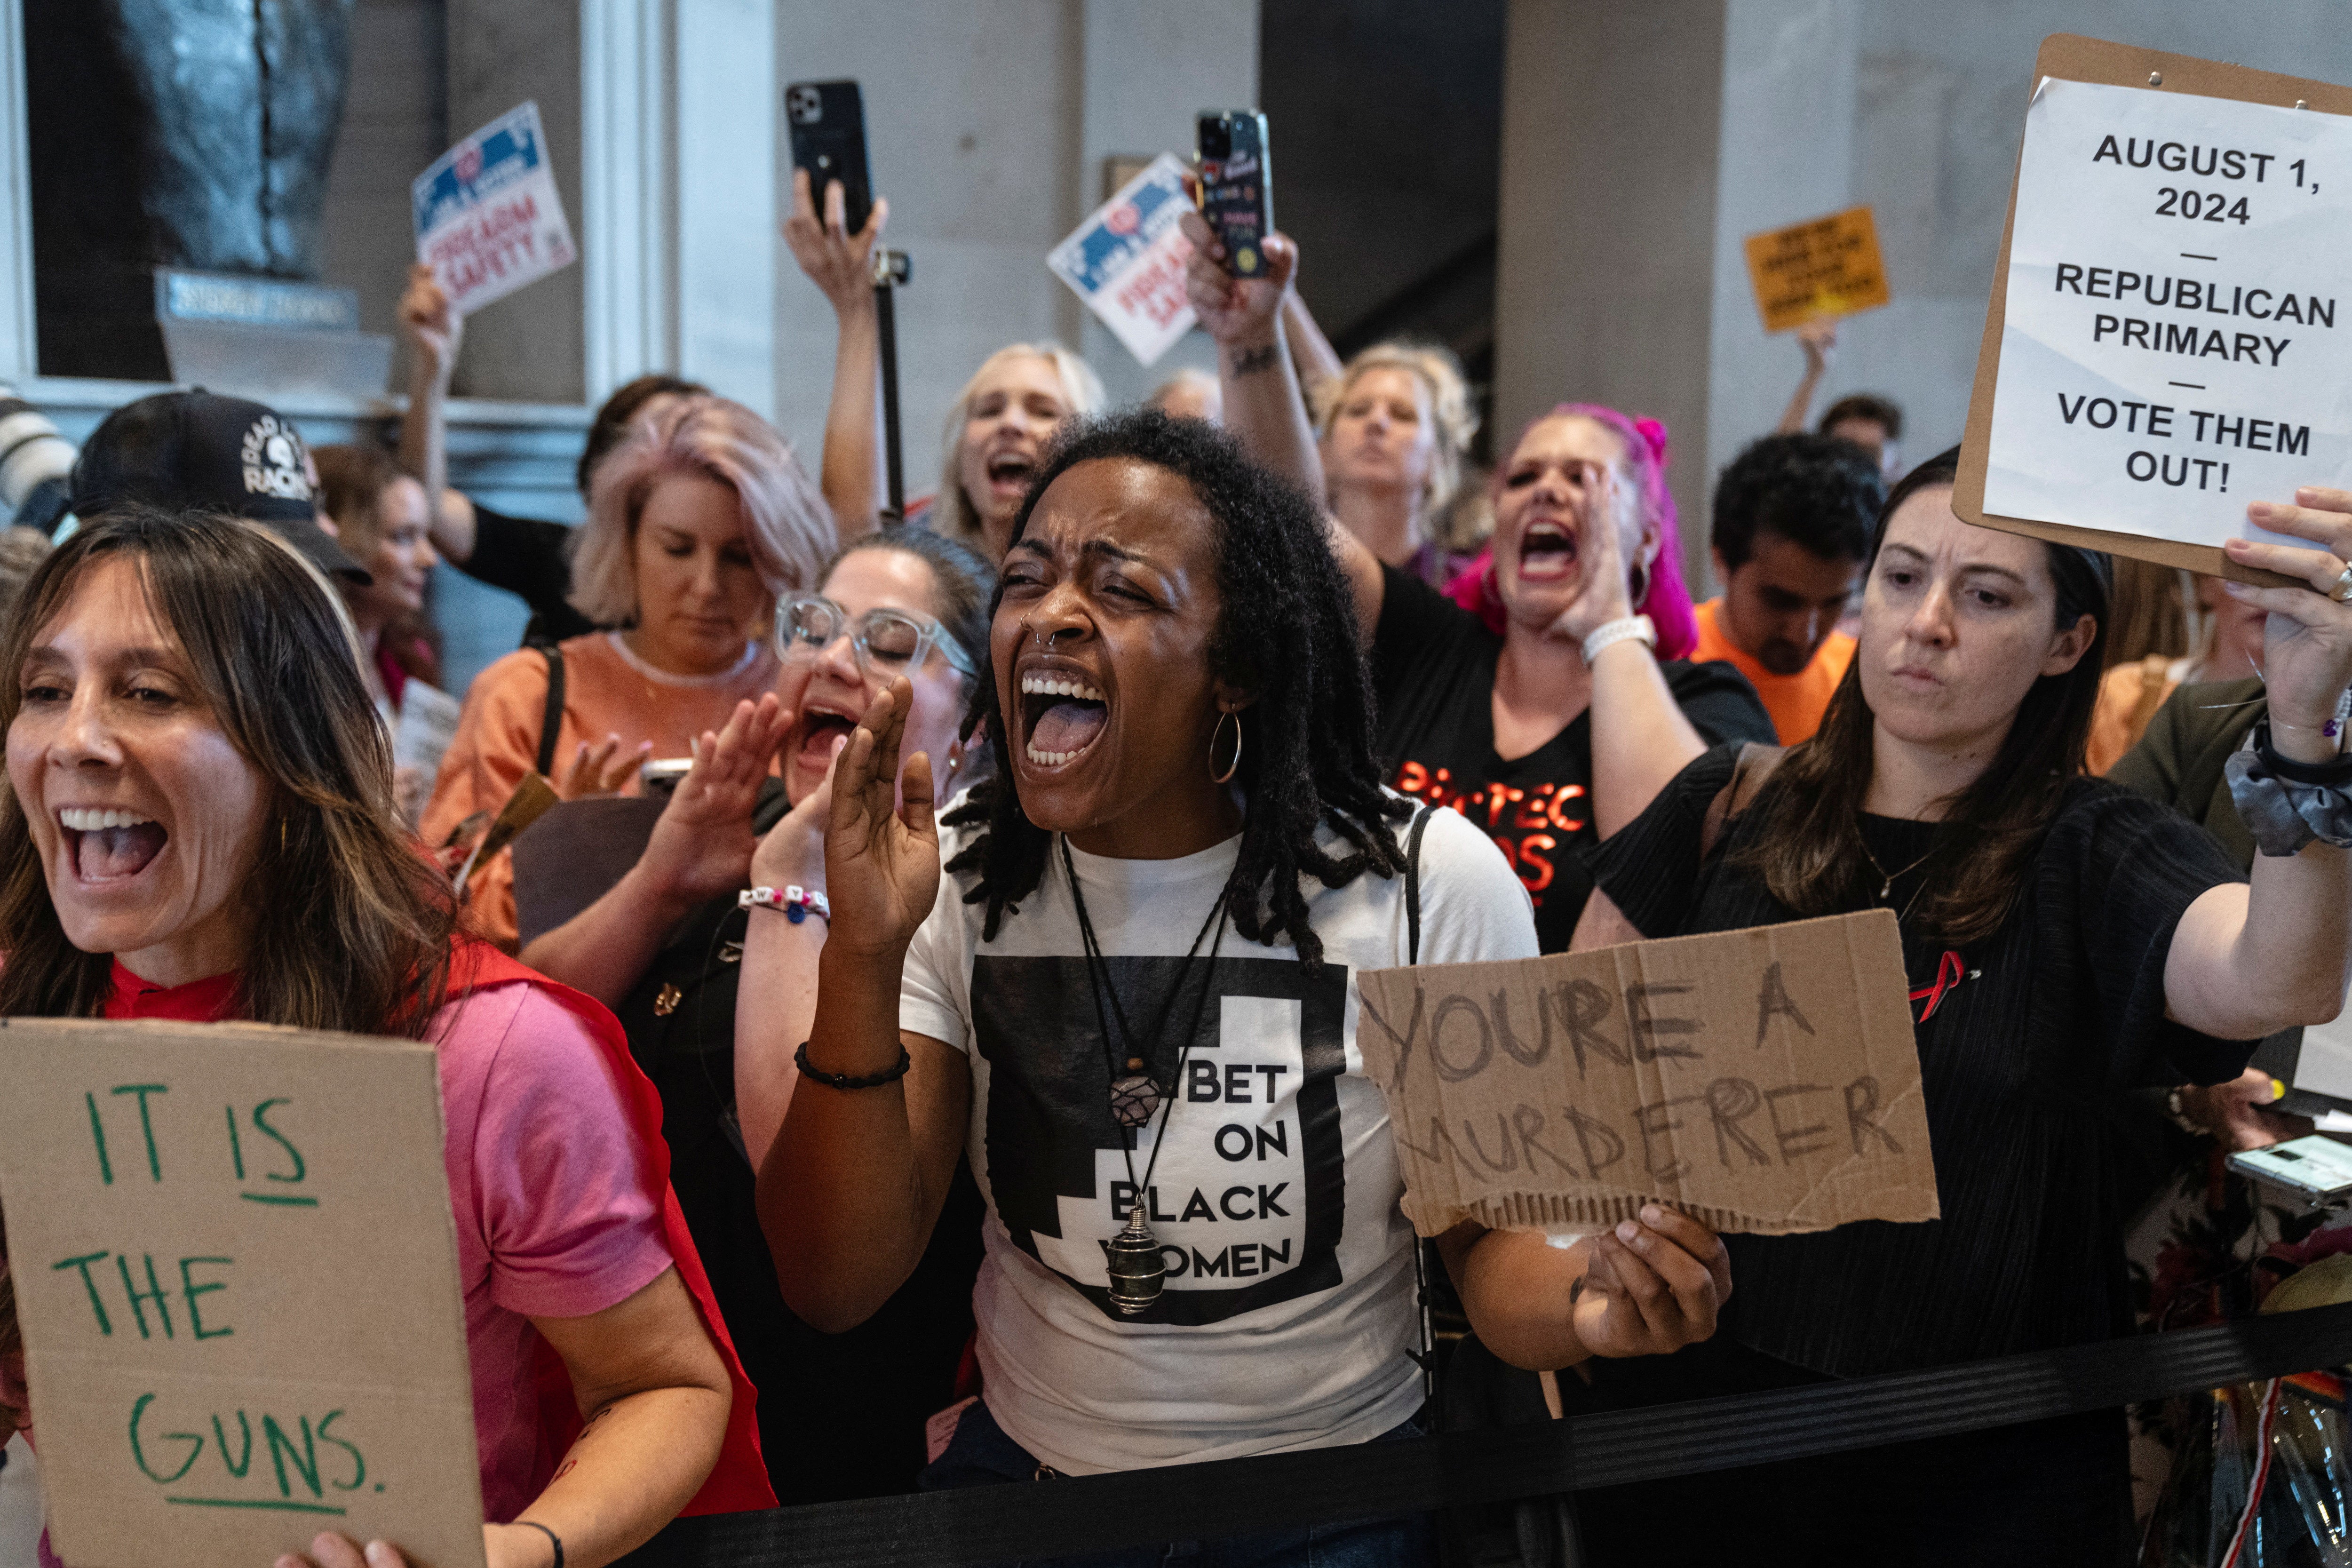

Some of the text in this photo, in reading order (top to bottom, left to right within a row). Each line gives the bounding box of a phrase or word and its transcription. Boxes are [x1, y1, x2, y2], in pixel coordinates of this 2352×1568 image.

[2092, 134, 2320, 196] AUGUST 1,
[2154, 187, 2251, 226] 2024
[2054, 263, 2336, 329] REPUBLICAN
[2093, 313, 2291, 367] PRIMARY
[2058, 392, 2311, 457] VOTE THEM
[2126, 450, 2230, 493] OUT!
[1359, 960, 1816, 1095] YOURE A
[1187, 1059, 1287, 1104] BET
[87, 1084, 307, 1185] IT IS
[1214, 1120, 1288, 1162] ON
[1397, 1075, 1904, 1186] MURDERER
[1110, 1181, 1291, 1223] BLACK
[1097, 1238, 1291, 1278] OMEN
[51, 1251, 235, 1341] THE
[129, 1393, 385, 1498] GUNS.
